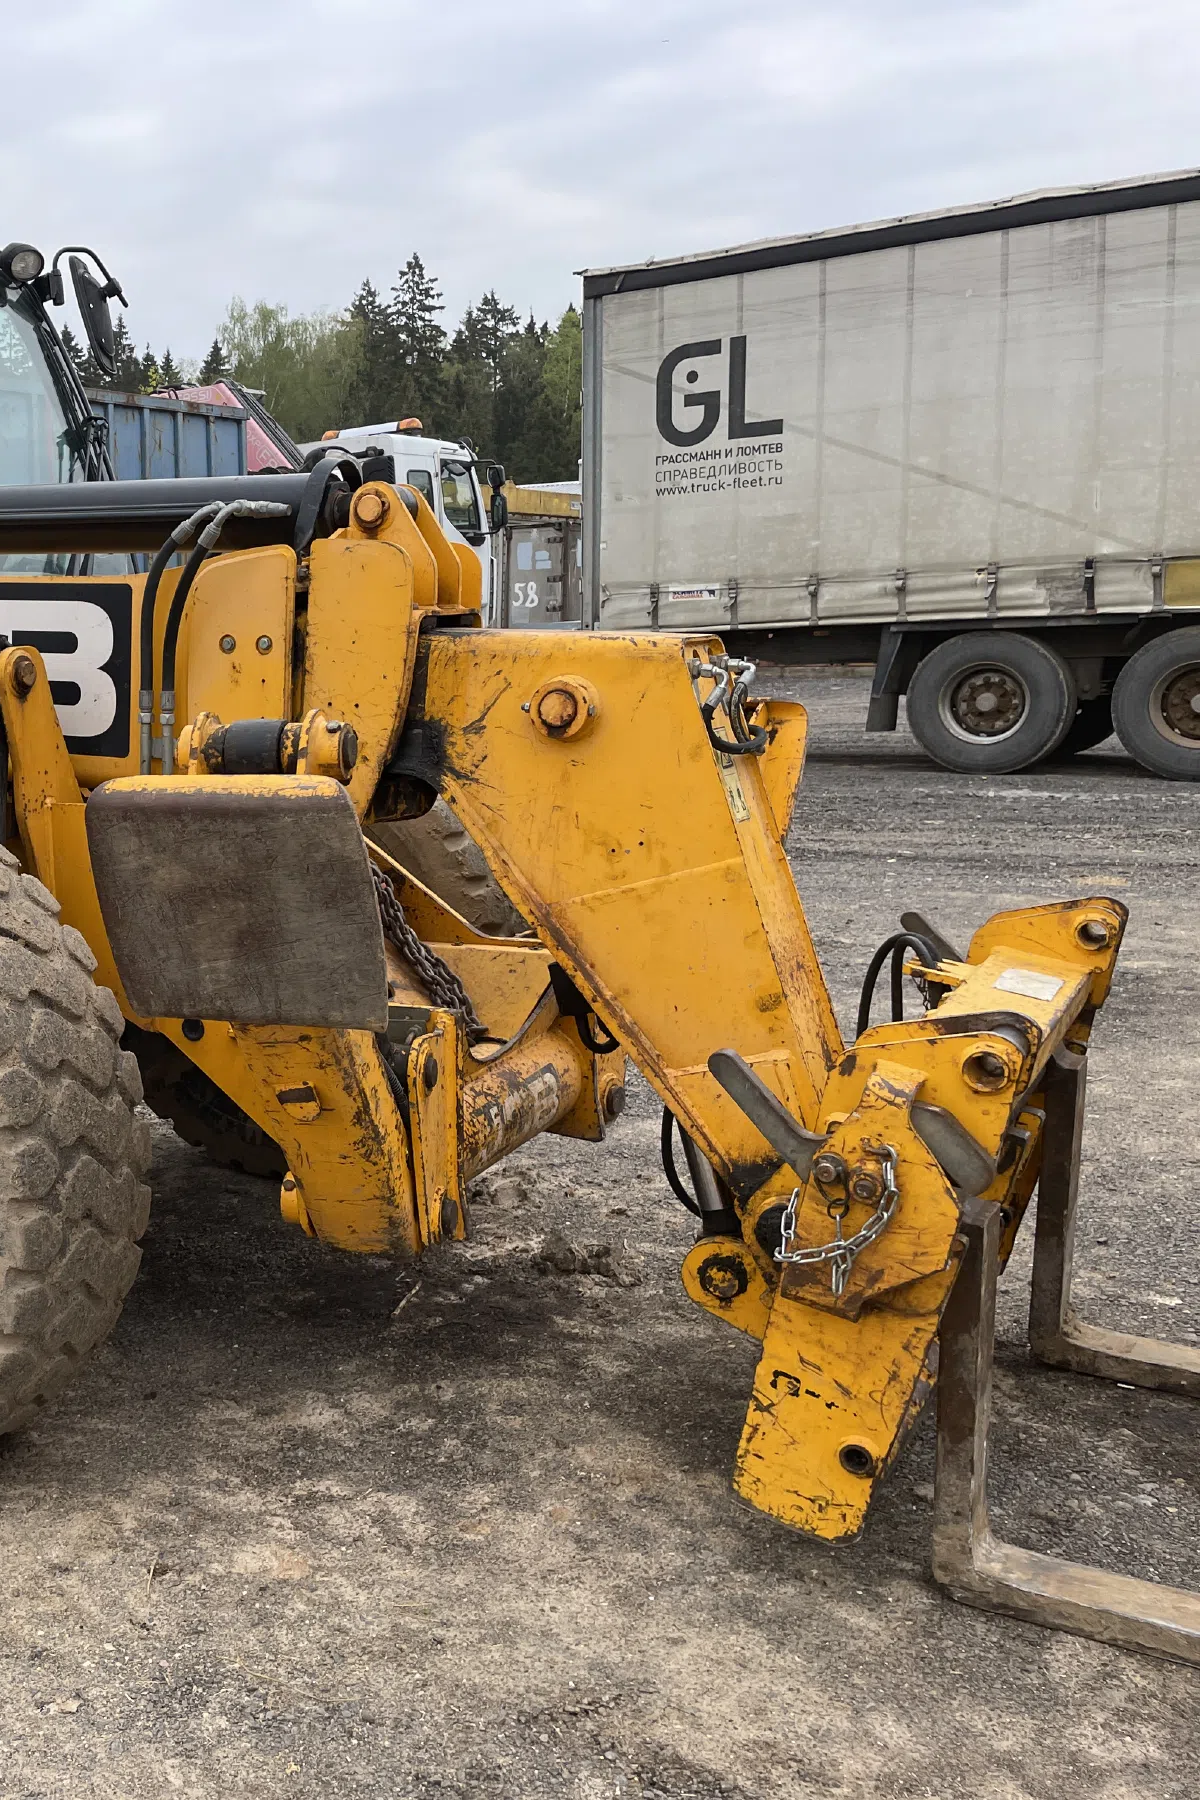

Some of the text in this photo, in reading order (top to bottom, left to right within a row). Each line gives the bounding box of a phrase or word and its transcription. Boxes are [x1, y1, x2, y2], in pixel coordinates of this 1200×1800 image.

[656, 335, 783, 447] GL
[655, 443, 783, 466] ГРАССМАНН И ЛОМТЕВ
[655, 459, 783, 483] СПРАВЕДЛИВОСТЬ
[655, 475, 783, 497] www.truck-fleet.ru
[512, 581, 539, 608] 58
